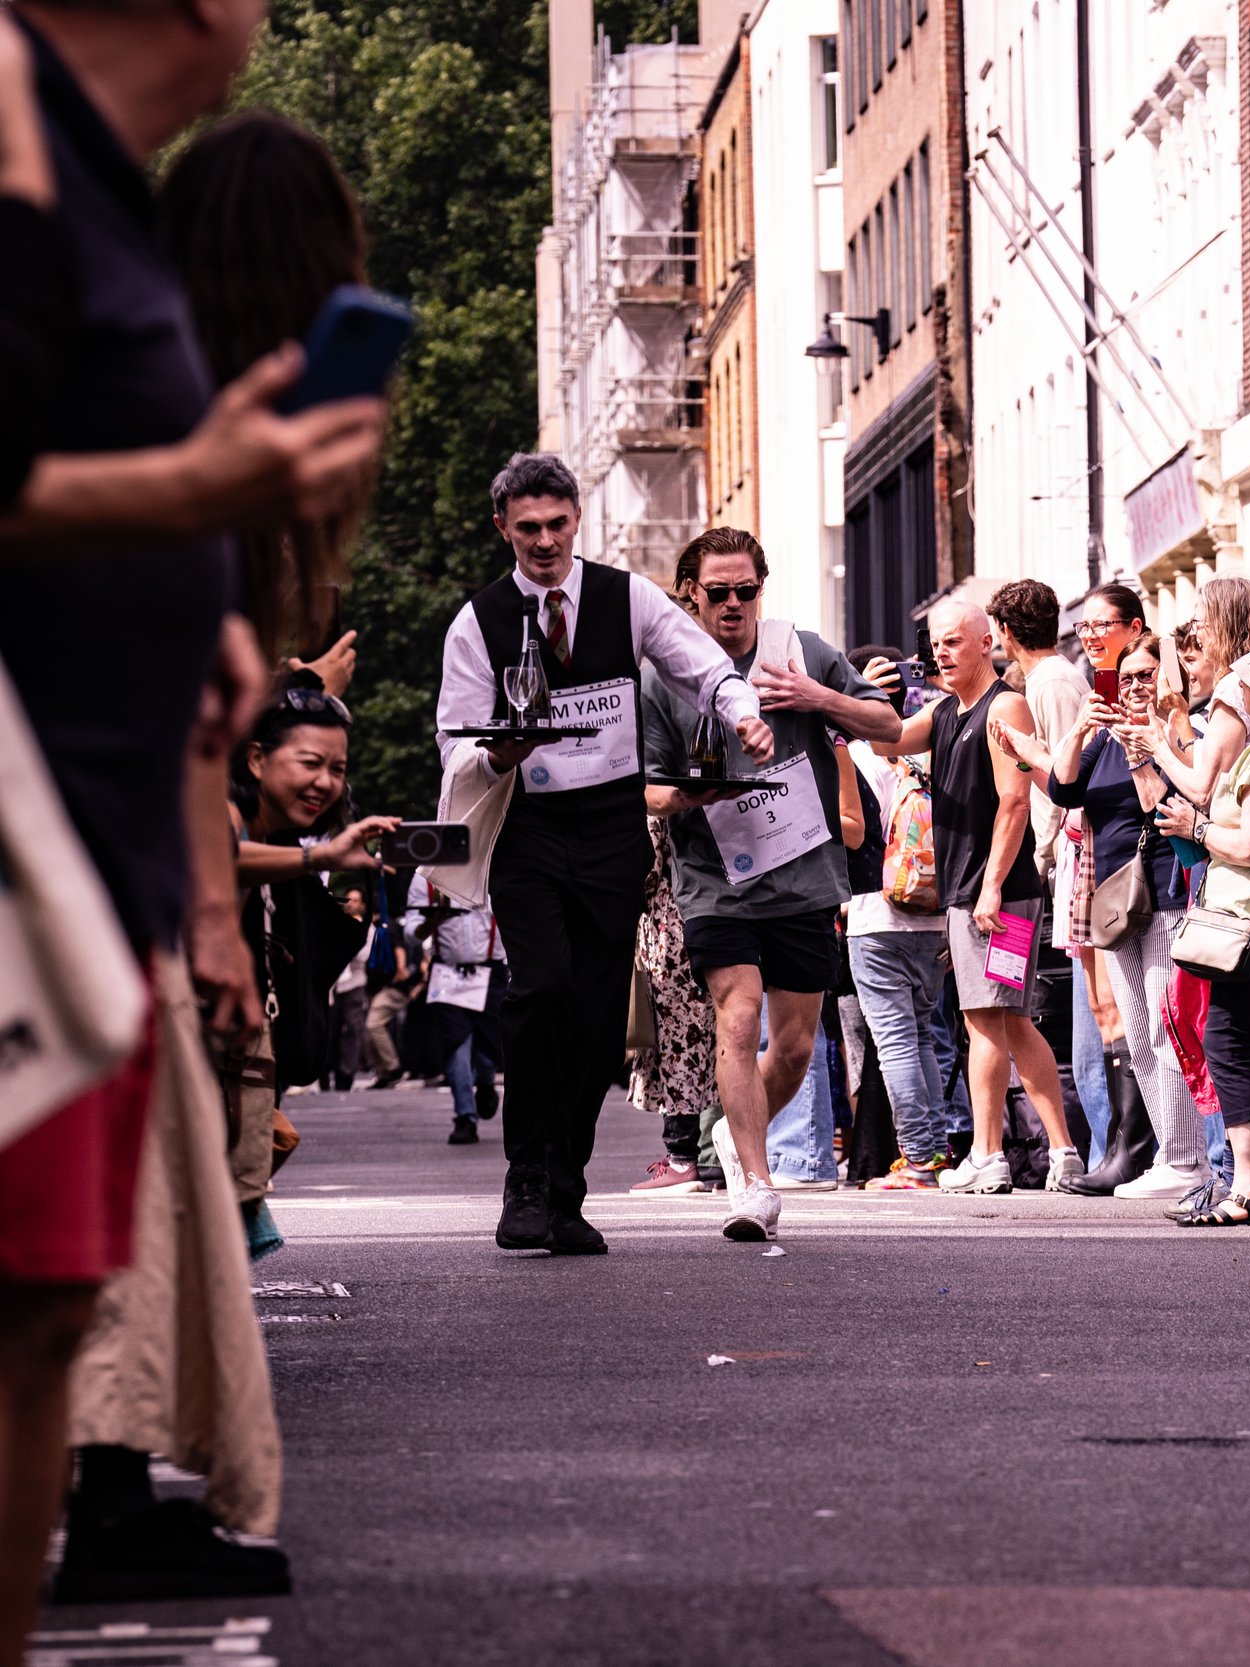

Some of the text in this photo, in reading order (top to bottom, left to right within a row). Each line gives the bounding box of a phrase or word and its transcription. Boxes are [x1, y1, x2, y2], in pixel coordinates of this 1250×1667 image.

[574, 694, 620, 716] YARD
[576, 736, 583, 747] 2
[736, 783, 789, 814] DOPPO
[766, 810, 776, 823] 3
